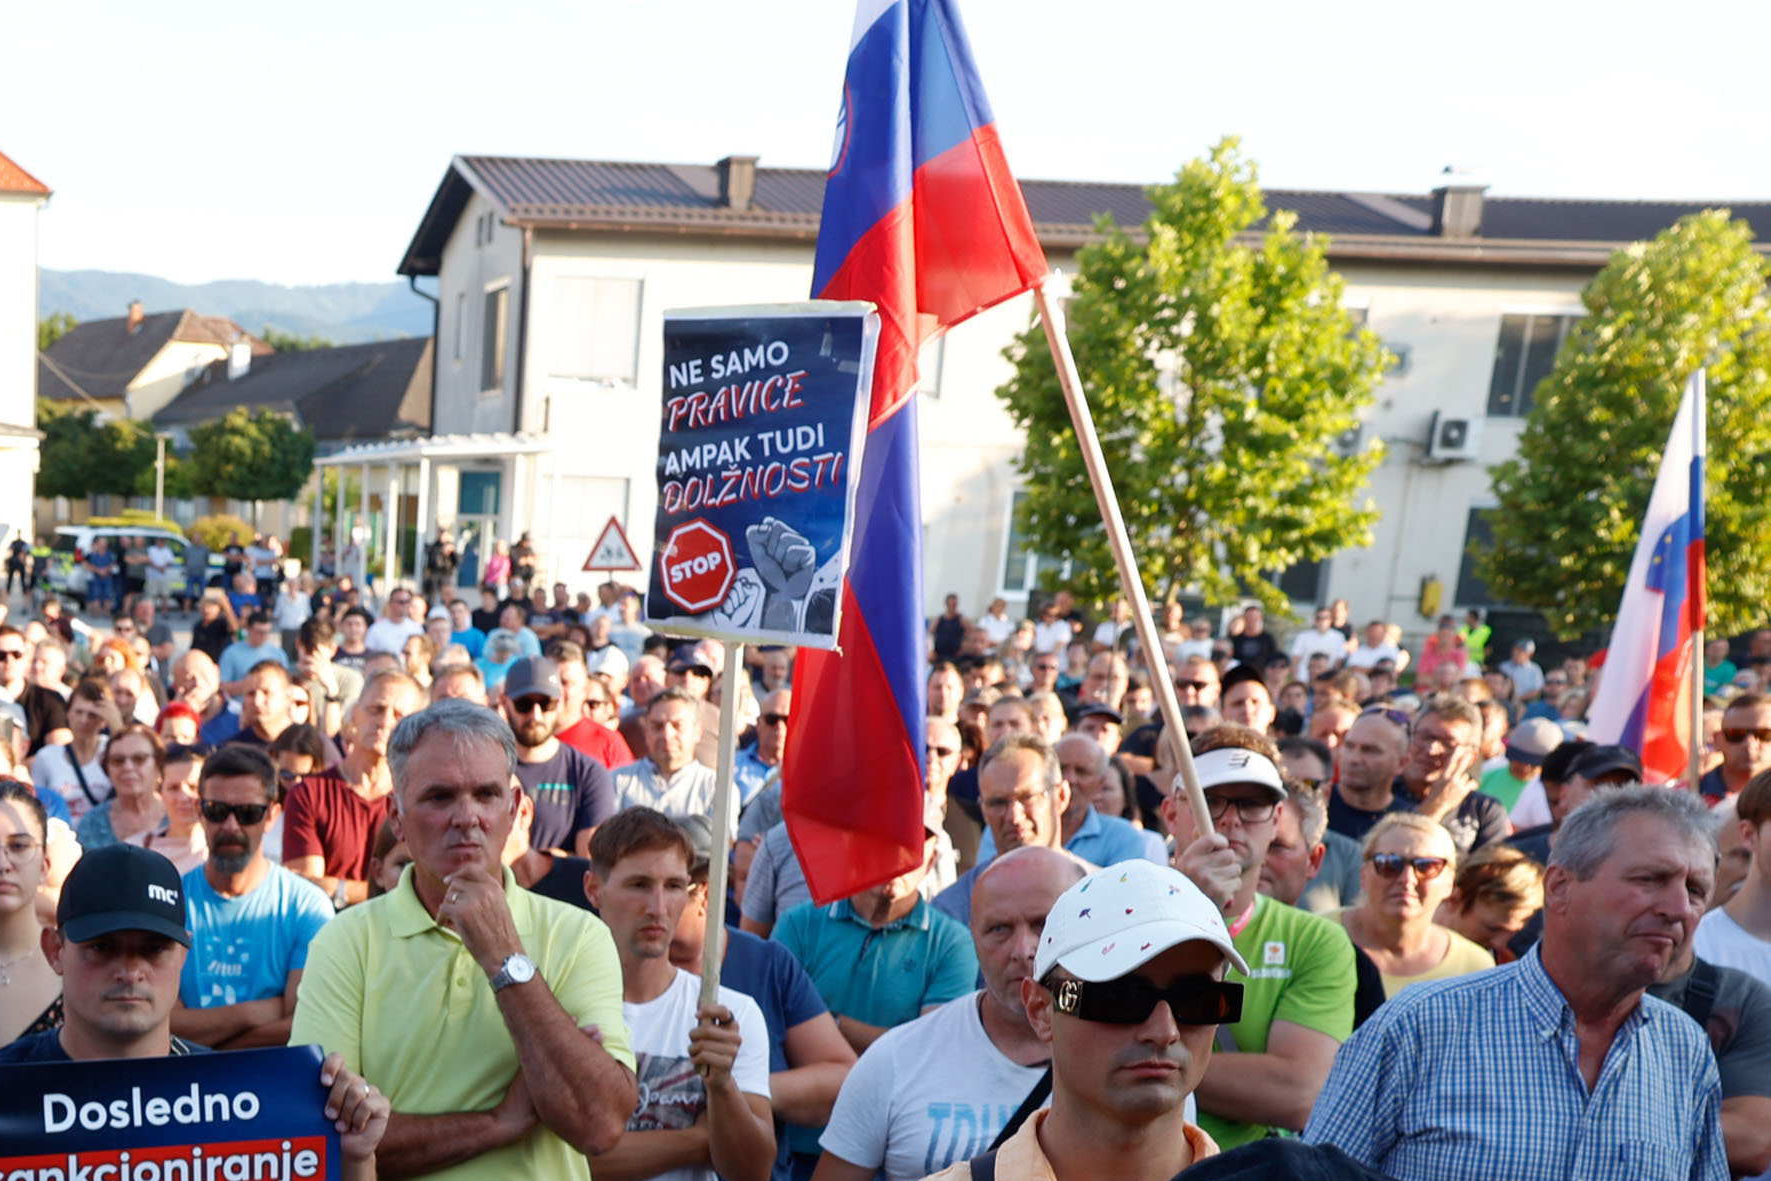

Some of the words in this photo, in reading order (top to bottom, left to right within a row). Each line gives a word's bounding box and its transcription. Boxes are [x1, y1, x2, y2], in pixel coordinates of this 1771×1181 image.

[669, 359, 705, 389] NE
[710, 340, 790, 379] SAMO
[667, 370, 809, 432] PRAVICE
[665, 436, 752, 476] AMPAK
[758, 422, 825, 457] TUDI
[663, 452, 844, 515] DOLŽNOSTI
[670, 551, 722, 583] STOP
[43, 1083, 260, 1134] Dosledno
